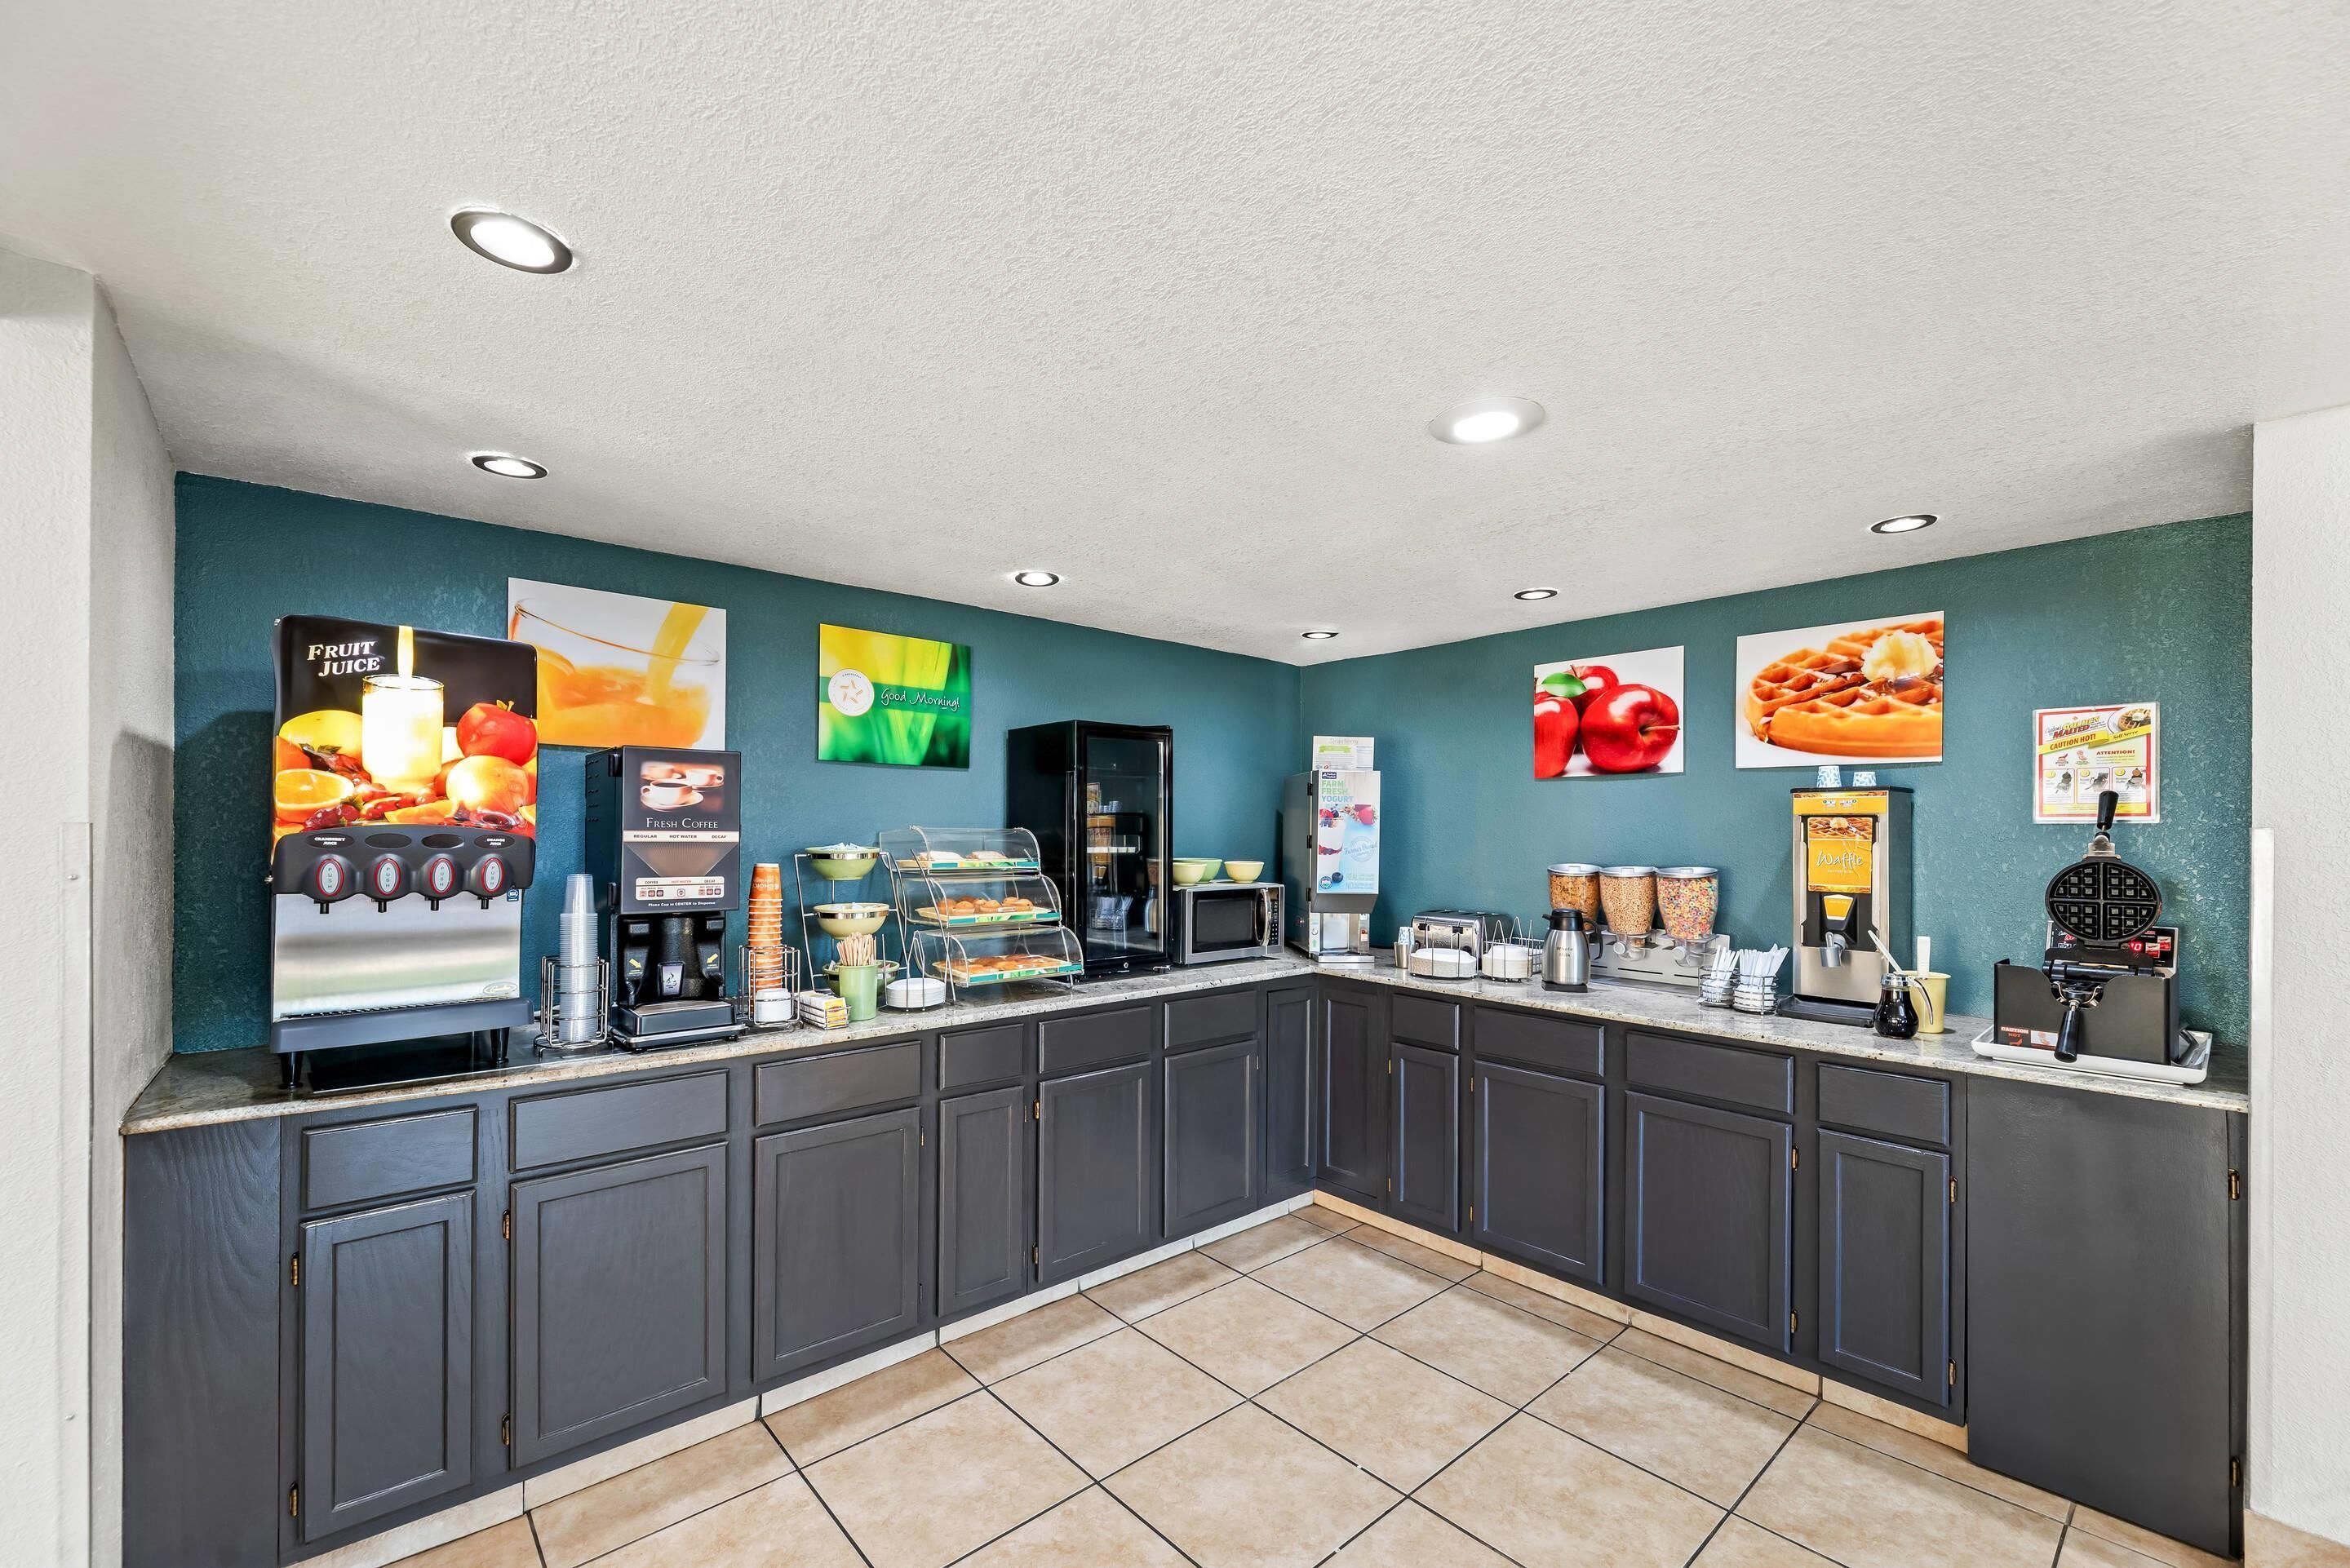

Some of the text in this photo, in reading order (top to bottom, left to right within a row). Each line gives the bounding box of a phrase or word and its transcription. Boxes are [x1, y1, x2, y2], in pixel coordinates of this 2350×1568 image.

[307, 641, 377, 660] FRUIT
[318, 657, 380, 676] JUICE
[881, 688, 960, 712] Good Morning!
[2053, 724, 2090, 738] MALTED
[2050, 733, 2096, 750] CAUTION HOT!
[646, 817, 718, 829] FRESH COFFEE
[1816, 850, 1864, 869] Waffle
